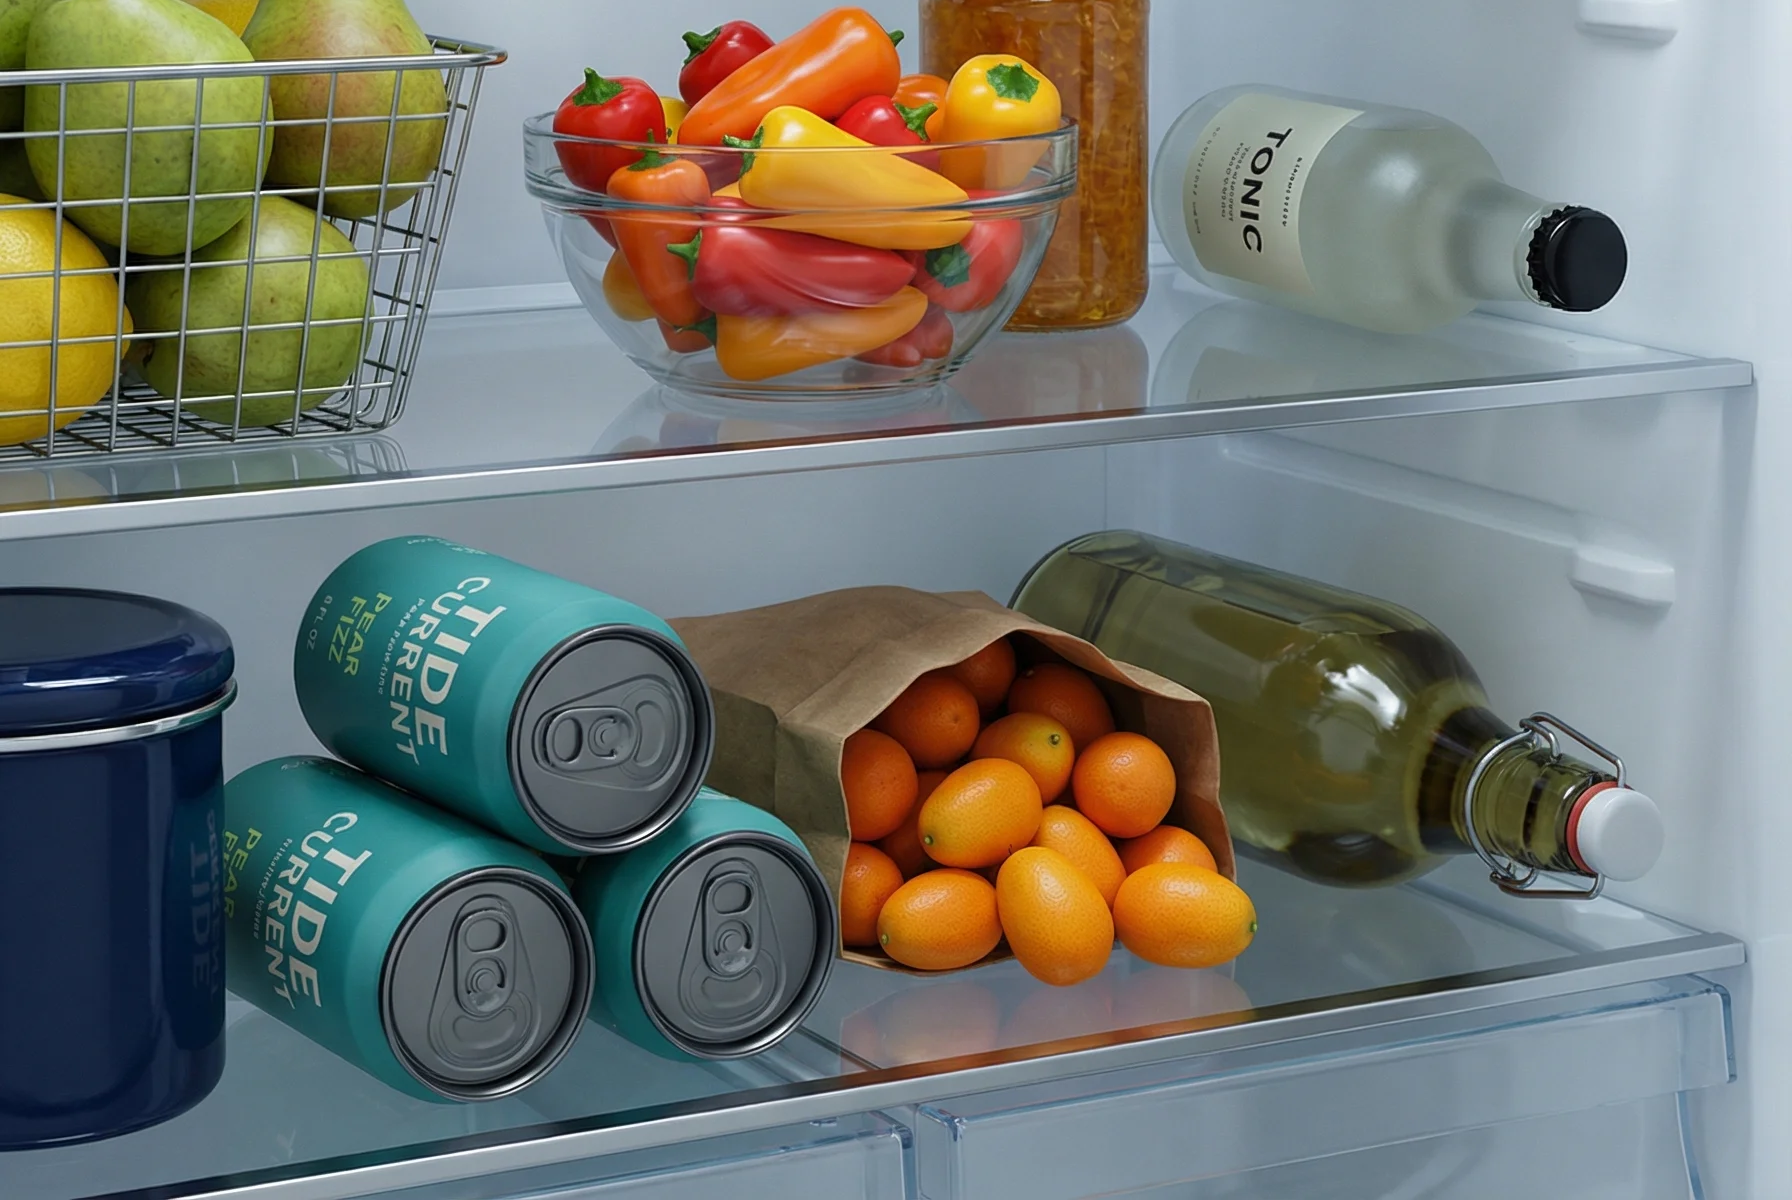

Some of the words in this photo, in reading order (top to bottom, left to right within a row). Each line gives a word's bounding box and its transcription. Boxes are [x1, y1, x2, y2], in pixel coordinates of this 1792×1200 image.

[1239, 127, 1293, 254] TONIC
[328, 595, 368, 664] FIZZ
[343, 592, 393, 676] PEAR
[390, 576, 491, 766] CURRENT
[415, 604, 507, 756] TIDE
[225, 827, 263, 919] PEAR
[265, 811, 358, 1010] CURRENT
[288, 847, 373, 1008] TIDE
